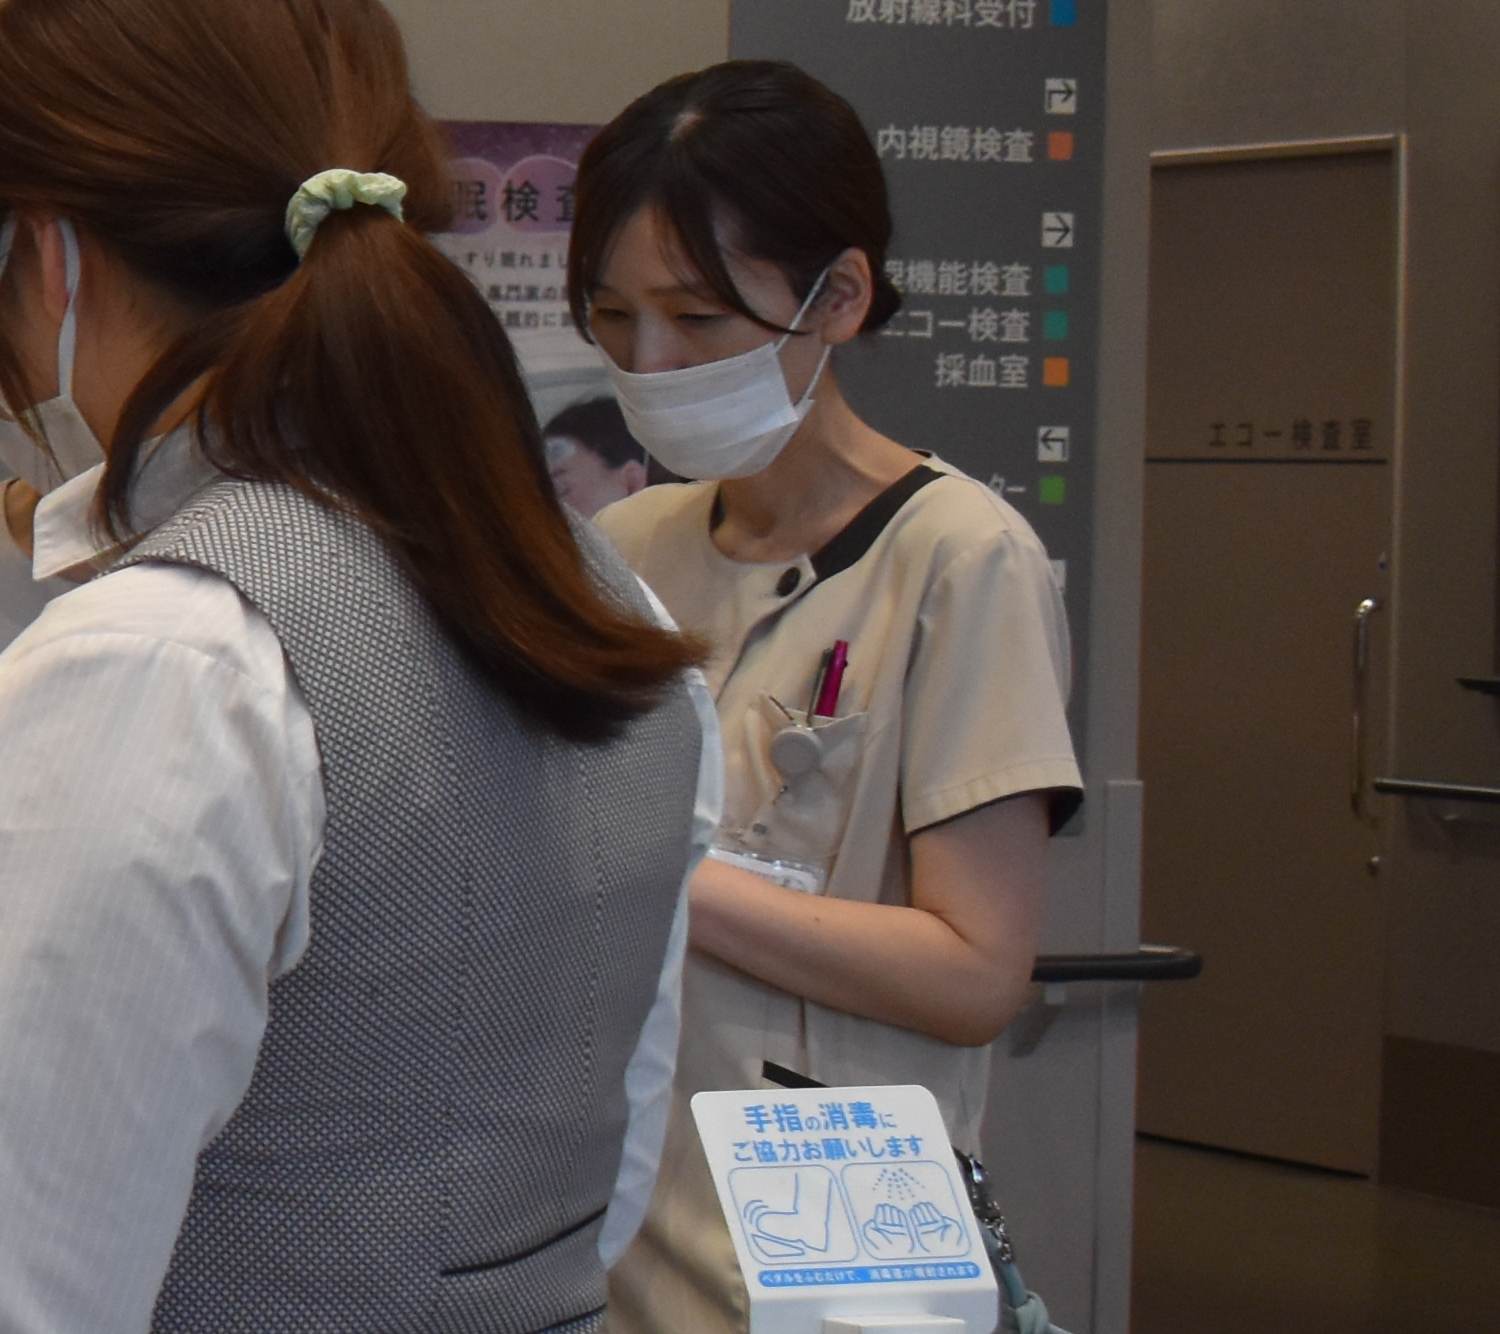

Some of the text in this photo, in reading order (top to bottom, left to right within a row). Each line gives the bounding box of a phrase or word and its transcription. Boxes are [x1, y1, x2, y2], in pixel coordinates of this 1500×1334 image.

[876, 123, 1035, 165] 内視鏡検査
[934, 352, 1029, 390] 採血室
[1207, 418, 1374, 451] エコー検査室
[742, 1100, 898, 1134] 手指の消毒に
[732, 1134, 924, 1164] ご協力お願いします
